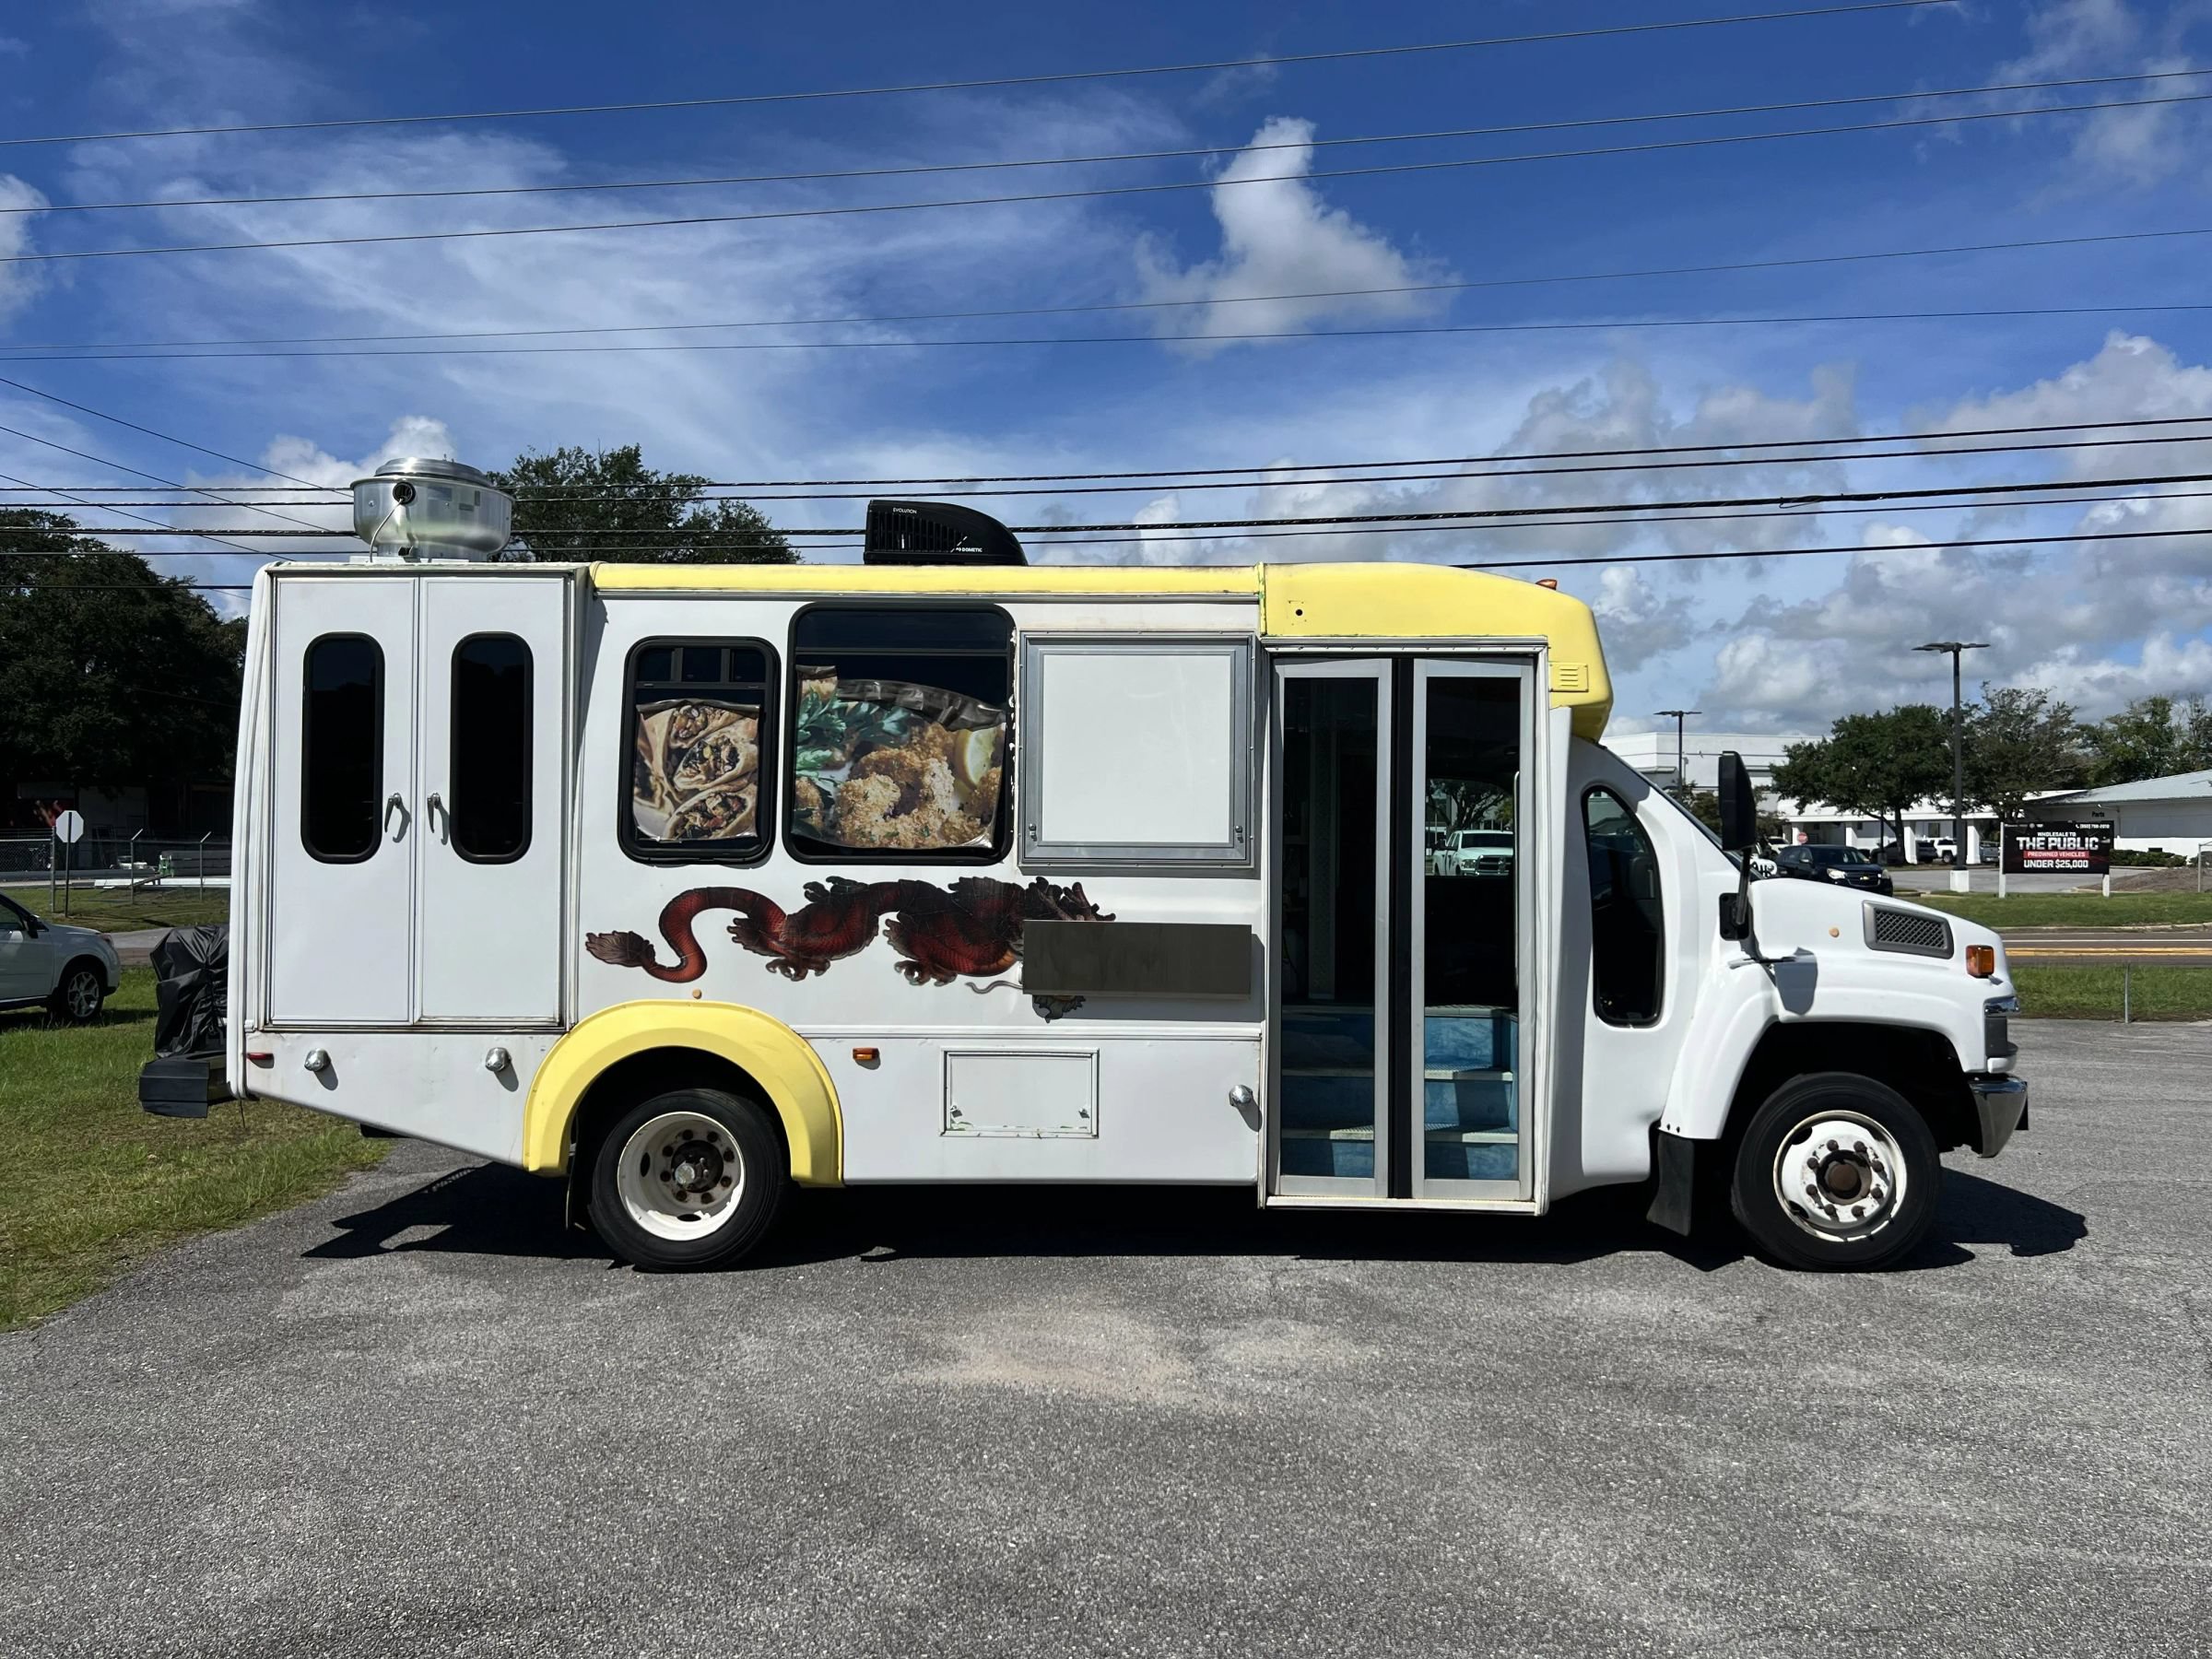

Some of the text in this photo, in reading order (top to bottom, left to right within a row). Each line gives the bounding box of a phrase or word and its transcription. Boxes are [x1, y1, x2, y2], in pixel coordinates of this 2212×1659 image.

[2016, 837, 2099, 850] THE PUBLIC
[2023, 858, 2088, 869] UNDER $25,000
